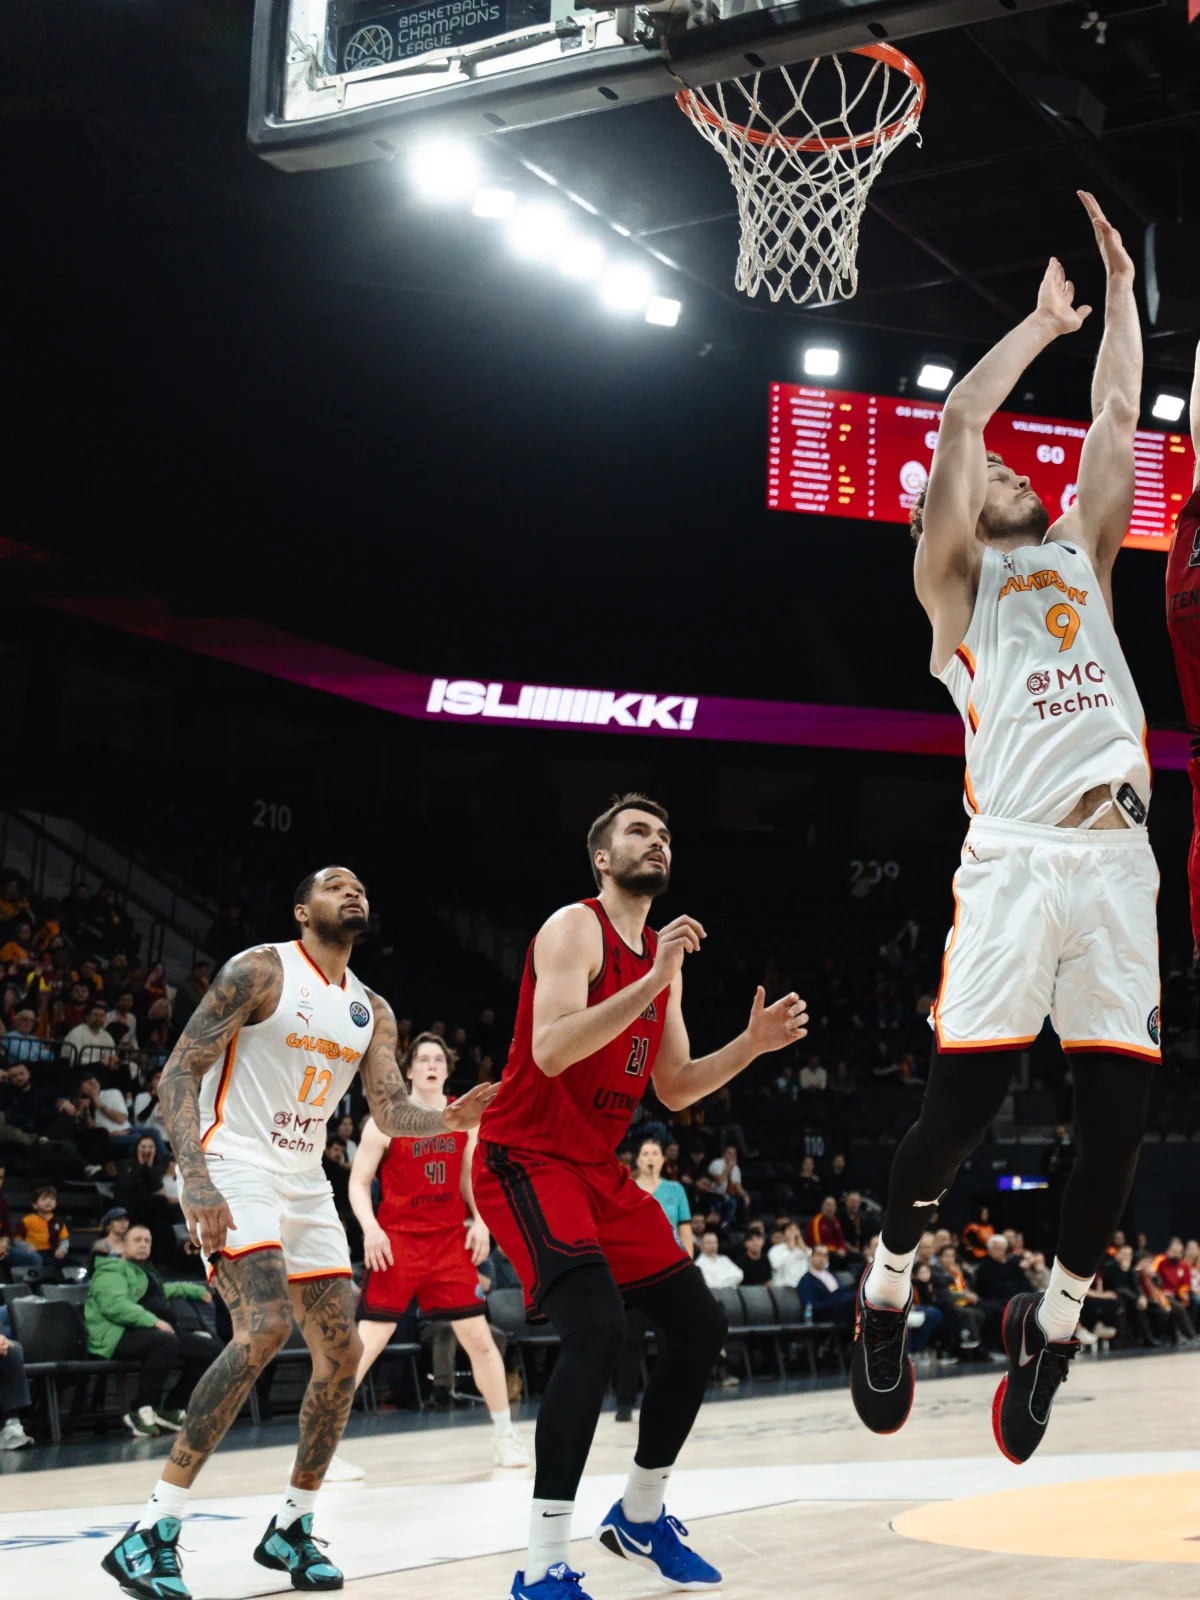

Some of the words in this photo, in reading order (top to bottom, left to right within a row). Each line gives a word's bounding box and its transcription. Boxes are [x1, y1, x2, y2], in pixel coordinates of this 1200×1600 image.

[397, 6, 500, 43] CHAMPIONS
[398, 0, 490, 28] BASKETBALL
[397, 34, 452, 57] LEAGUE
[1036, 444, 1065, 465] 60
[1045, 602, 1081, 653] 9
[1056, 660, 1106, 690] MC
[252, 800, 292, 833] 210
[625, 1035, 650, 1077] 21
[297, 1065, 333, 1107] 12
[270, 1131, 315, 1153] Techn
[412, 1137, 456, 1158] RYTAS
[424, 1160, 446, 1185] 41
